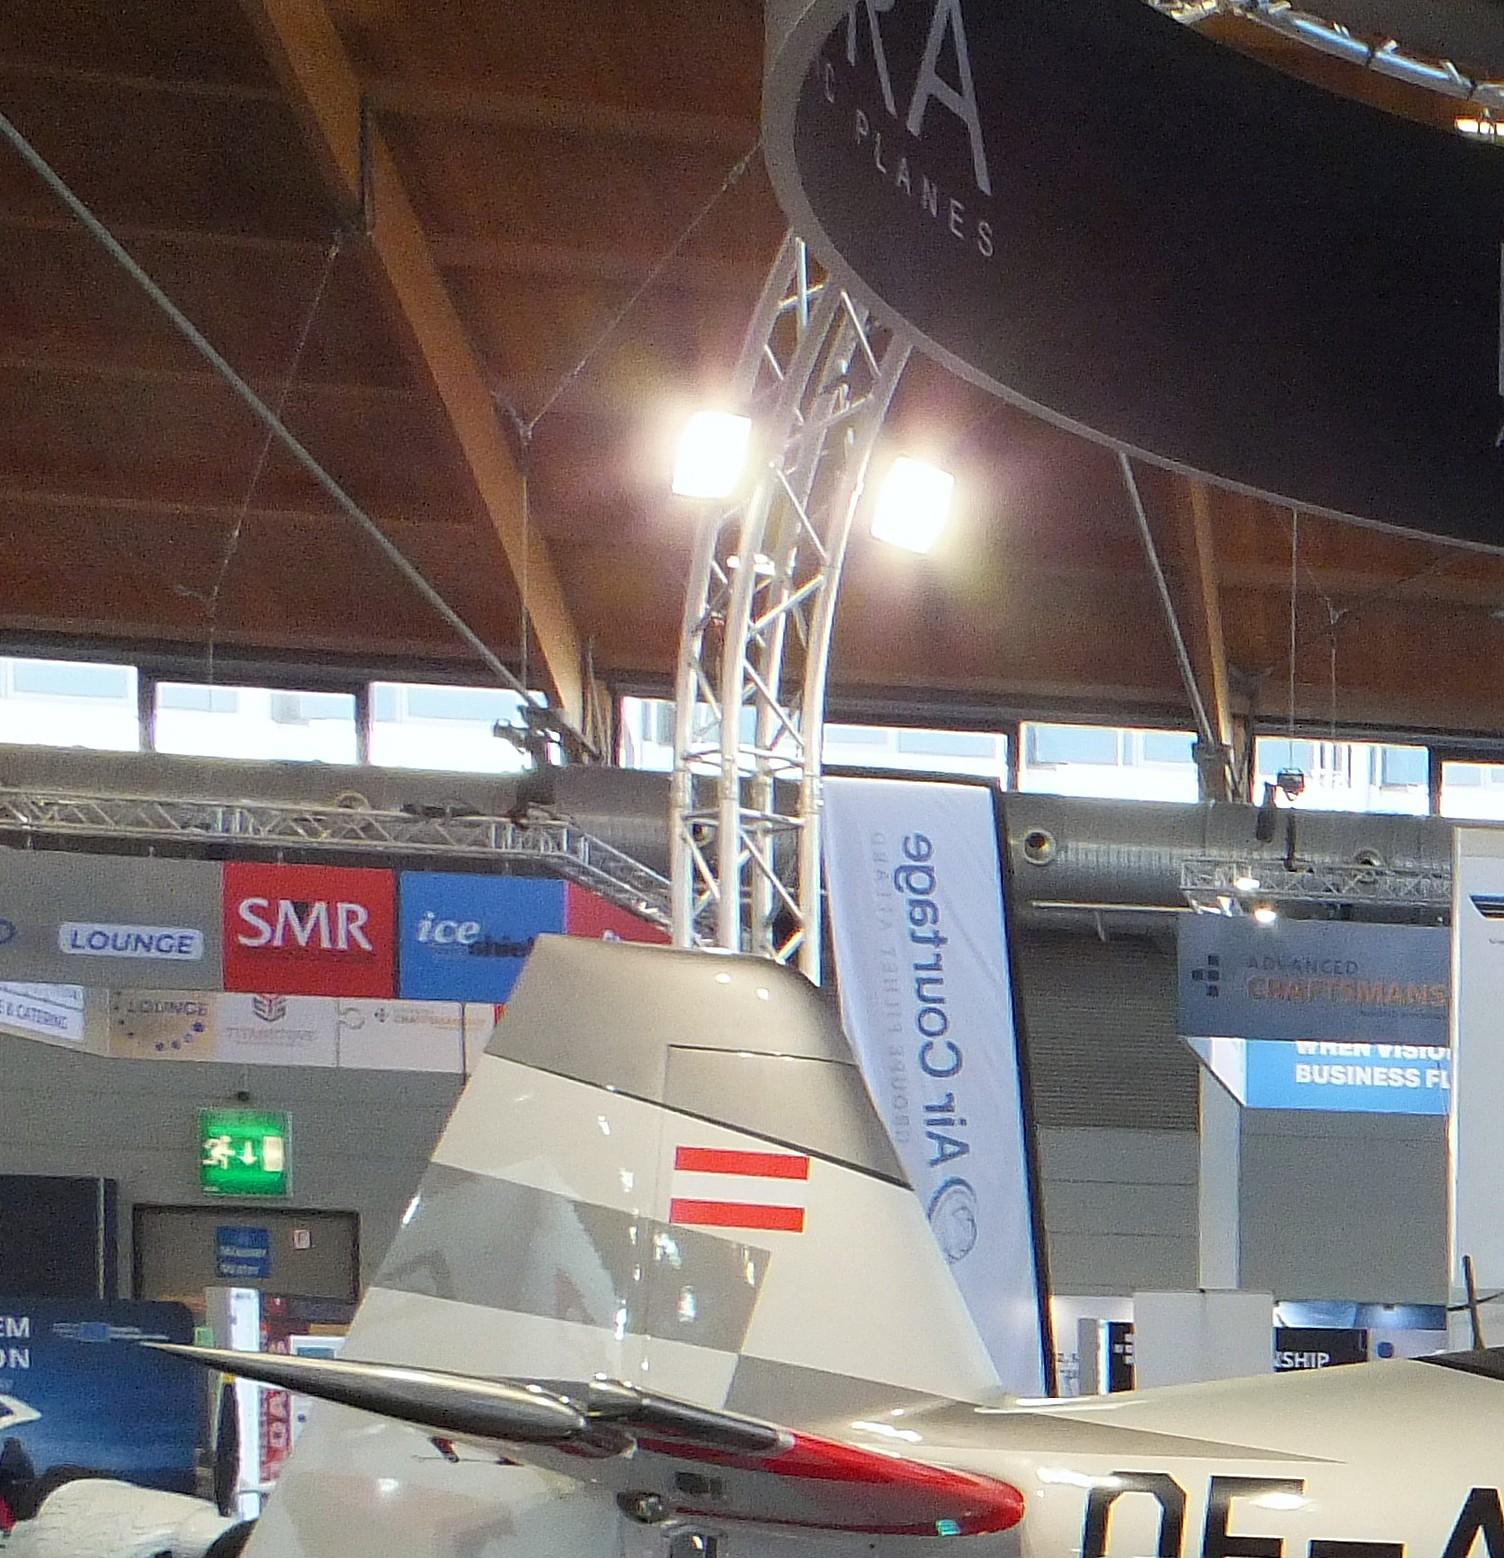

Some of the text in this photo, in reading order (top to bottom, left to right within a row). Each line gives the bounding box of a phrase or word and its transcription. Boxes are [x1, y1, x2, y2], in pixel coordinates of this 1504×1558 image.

[855, 108, 995, 258] PLANES
[238, 897, 374, 951] SMR
[416, 911, 481, 944] ice
[70, 928, 195, 955] LOUNGE
[1248, 956, 1359, 976] ADVANCED
[1295, 1064, 1421, 1088] BUSINESS
